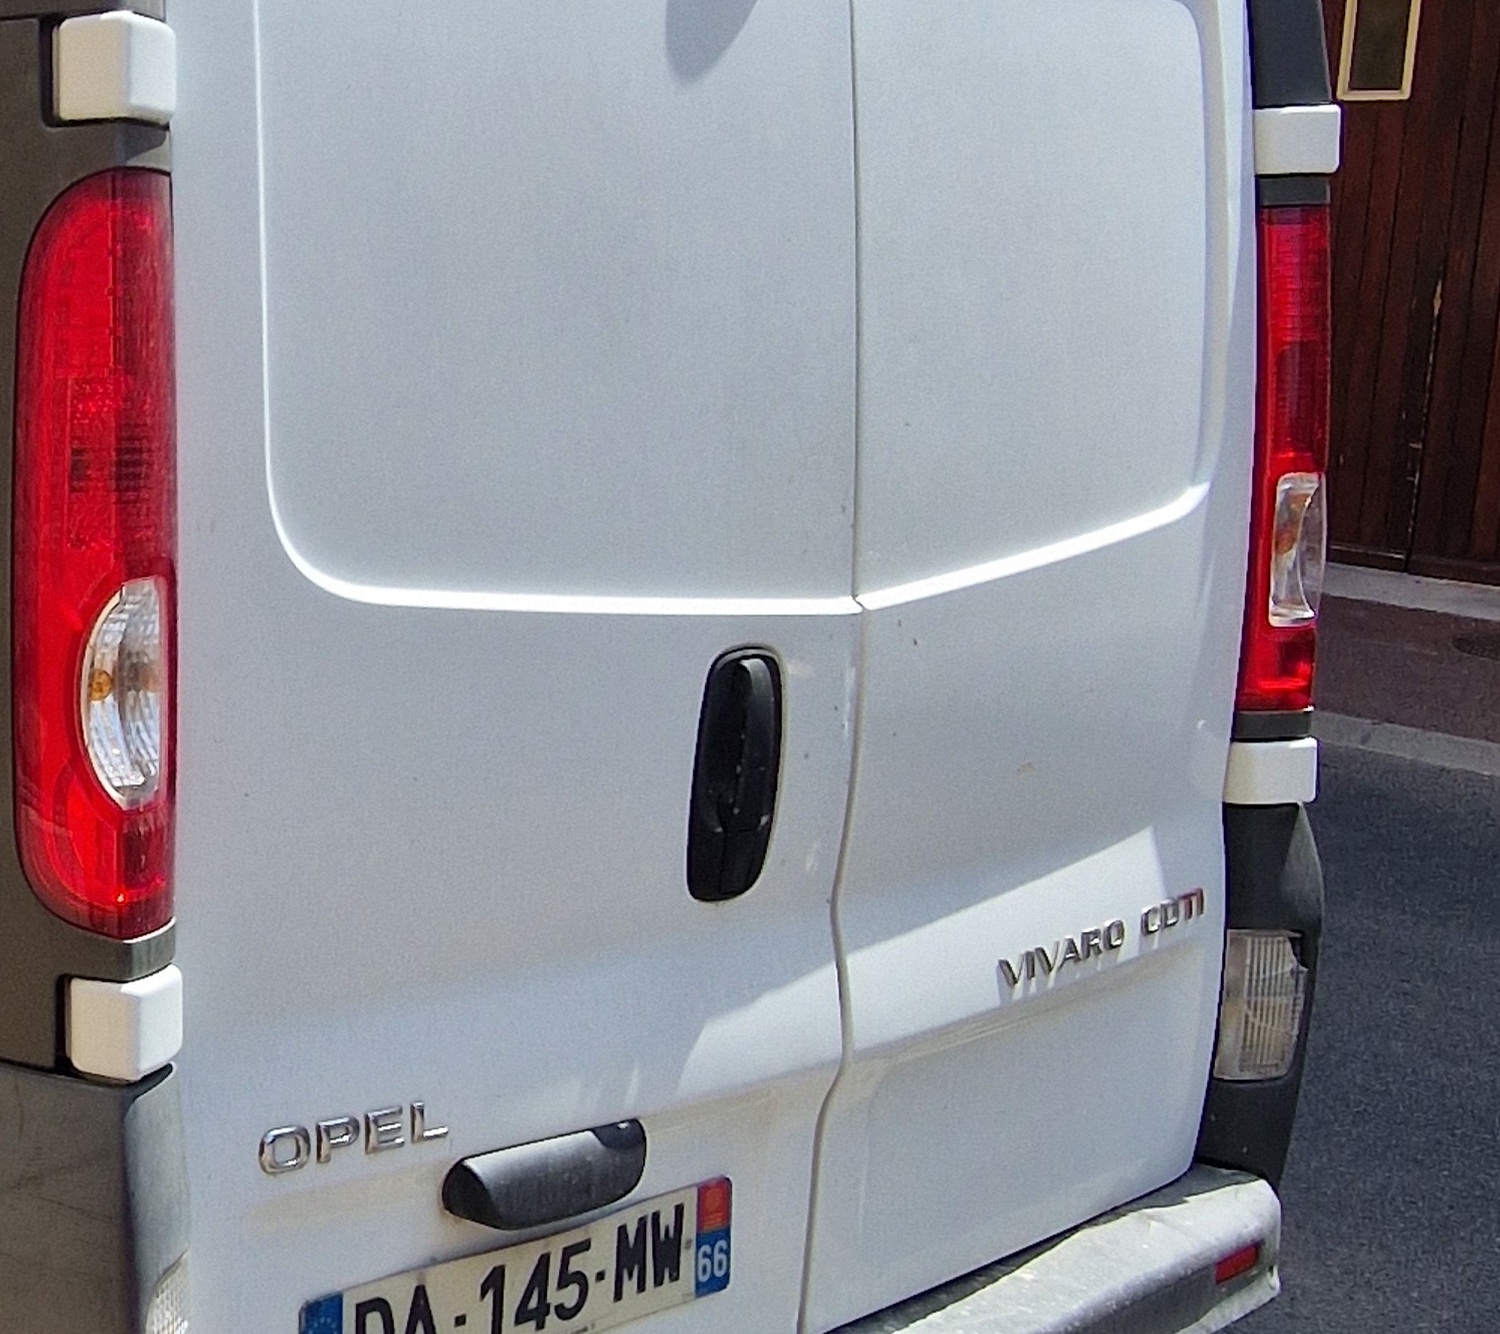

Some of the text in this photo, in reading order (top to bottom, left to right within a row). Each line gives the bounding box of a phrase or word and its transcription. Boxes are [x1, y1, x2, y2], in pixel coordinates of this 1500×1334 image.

[998, 887, 1205, 987] VIVARO CDTI
[258, 1100, 449, 1175] OPEL
[697, 1238, 729, 1284] 66
